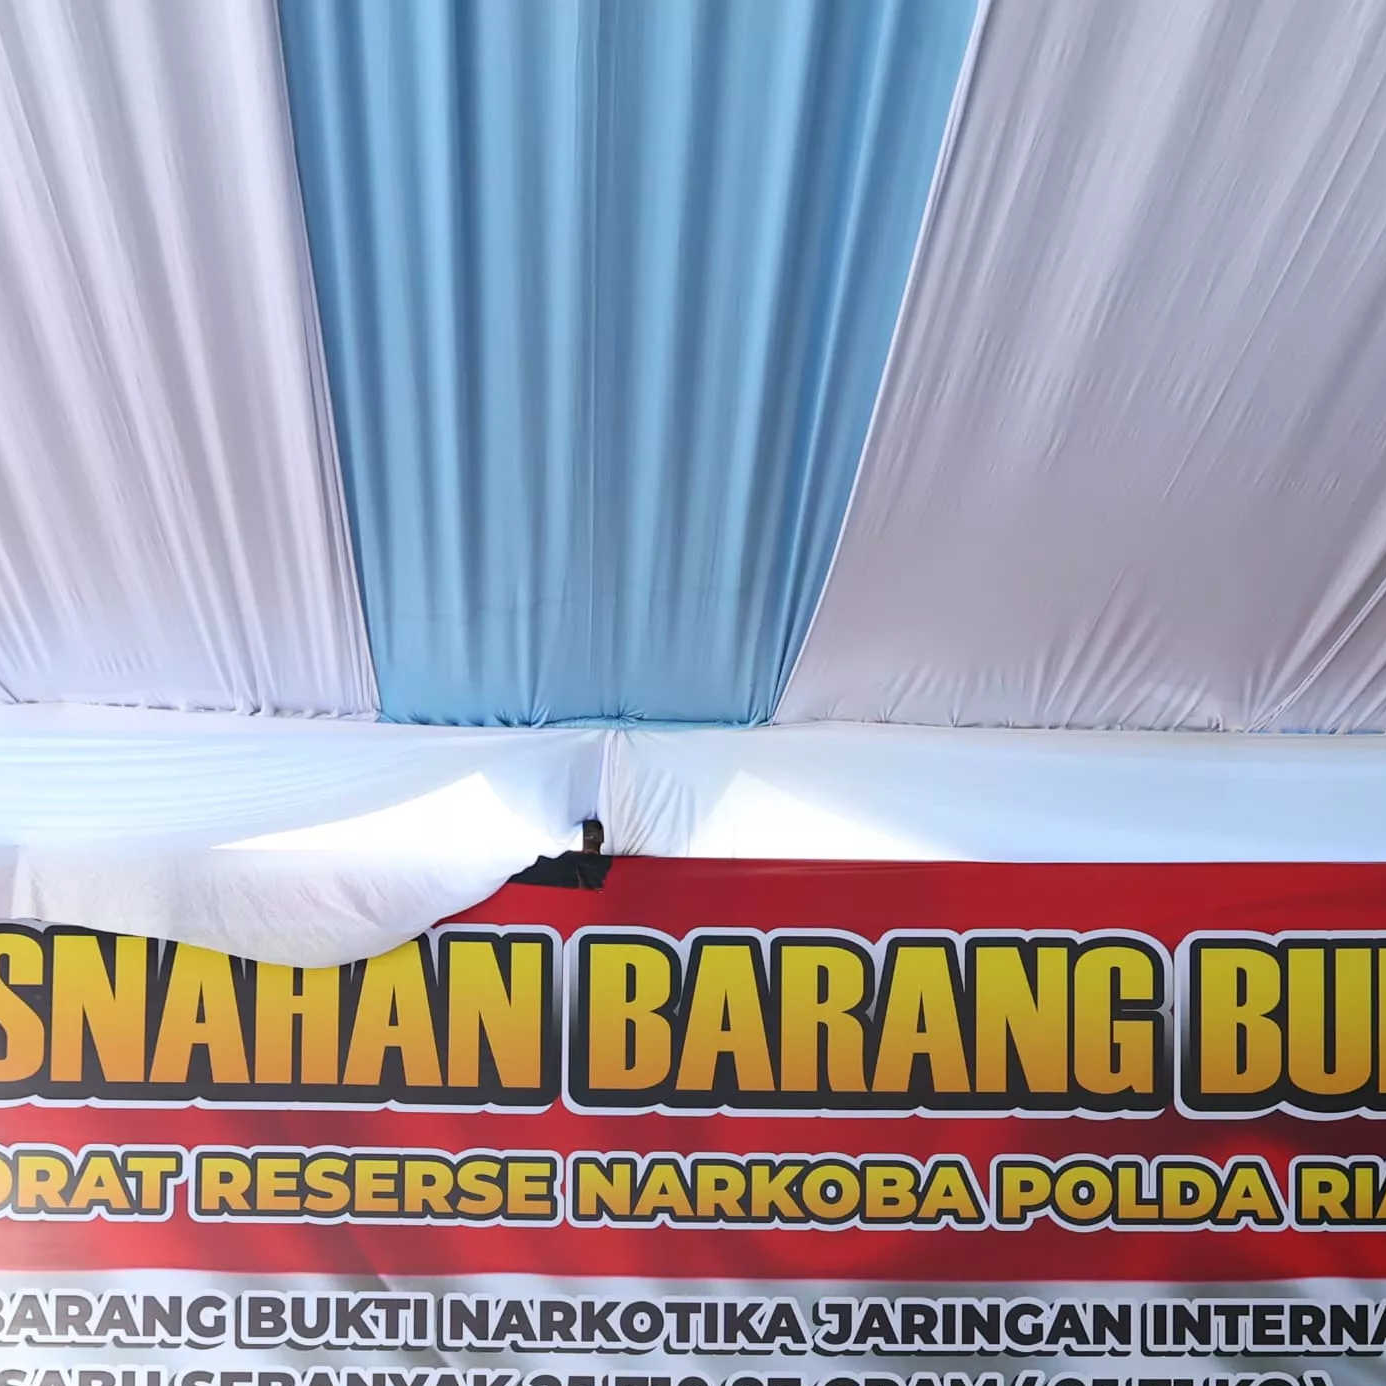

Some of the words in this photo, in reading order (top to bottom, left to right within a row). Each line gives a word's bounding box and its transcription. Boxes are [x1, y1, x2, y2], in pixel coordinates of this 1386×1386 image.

[588, 943, 1154, 1094] BARANG
[200, 1157, 552, 1215] RESERSE
[579, 1162, 978, 1217] NARKOBA
[1002, 1165, 1279, 1220] POLDA
[248, 1297, 426, 1338] BUKTI
[449, 1299, 807, 1345] NARKOTIKA
[830, 1302, 1132, 1346] JARINGAN
